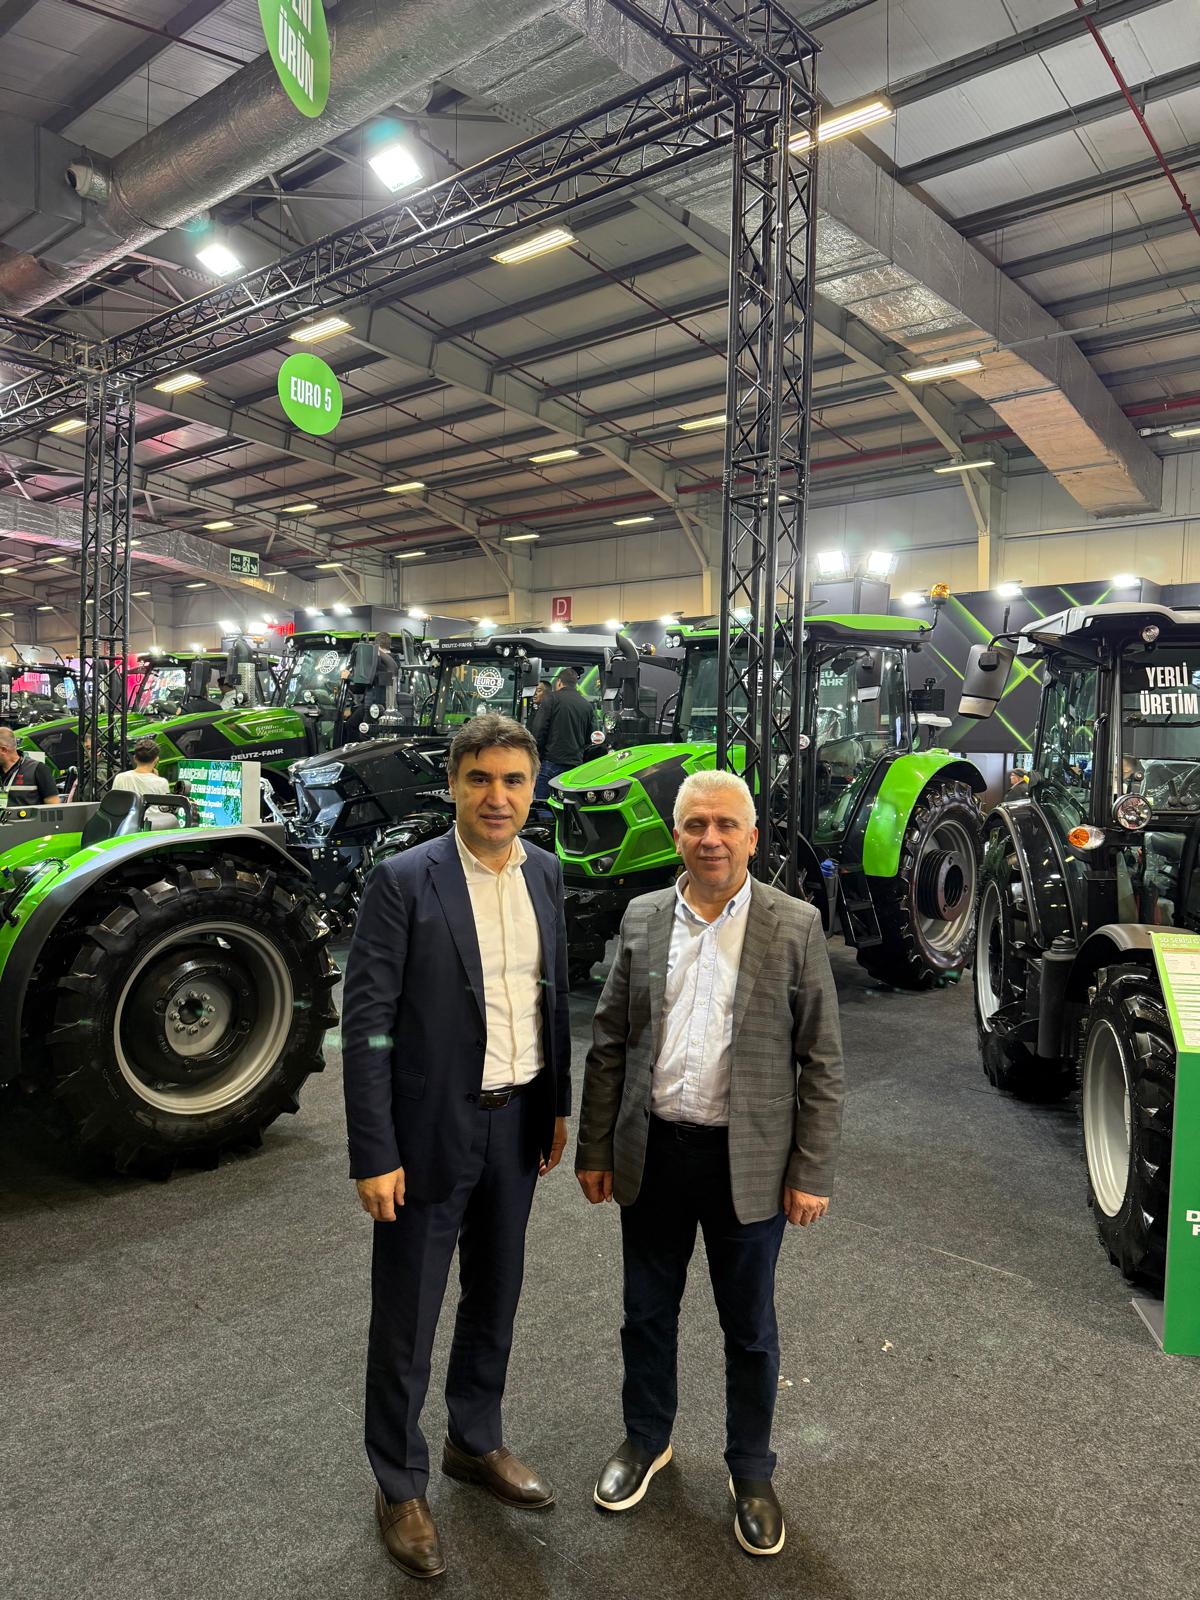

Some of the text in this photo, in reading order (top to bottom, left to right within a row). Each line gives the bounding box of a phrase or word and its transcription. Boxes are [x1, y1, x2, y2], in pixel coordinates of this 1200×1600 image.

[278, 4, 314, 103] ÜRÜN
[291, 376, 332, 413] EURO 5
[556, 599, 567, 616] D
[476, 678, 496, 686] EURO
[1145, 661, 1189, 688] YERLİ
[1139, 690, 1199, 715] ÜRETİM
[230, 748, 284, 761] DEUTZ-FAHR
